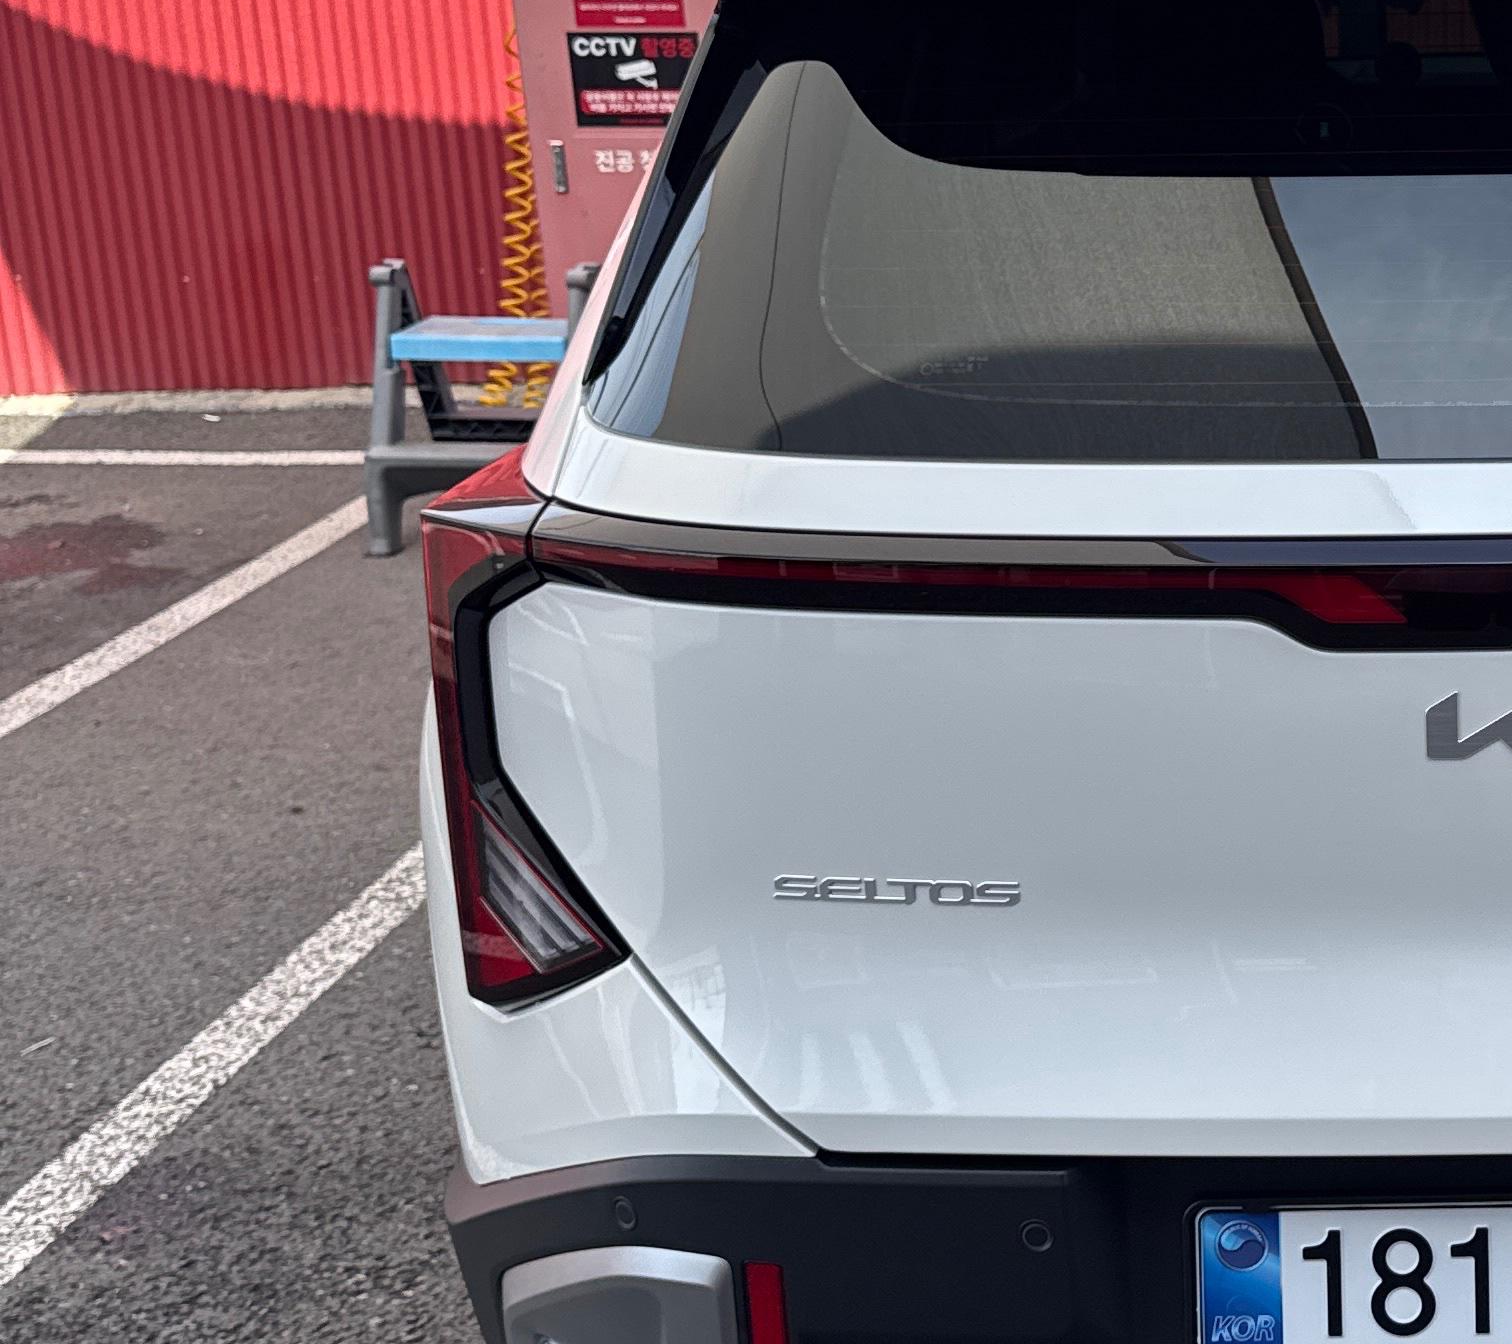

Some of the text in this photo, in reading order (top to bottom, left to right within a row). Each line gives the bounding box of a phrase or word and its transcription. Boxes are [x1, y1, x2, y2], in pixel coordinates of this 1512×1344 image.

[572, 36, 637, 58] CCTV
[594, 149, 635, 174] 진공
[773, 873, 1022, 908] SELTOS
[1210, 1314, 1276, 1343] KOR
